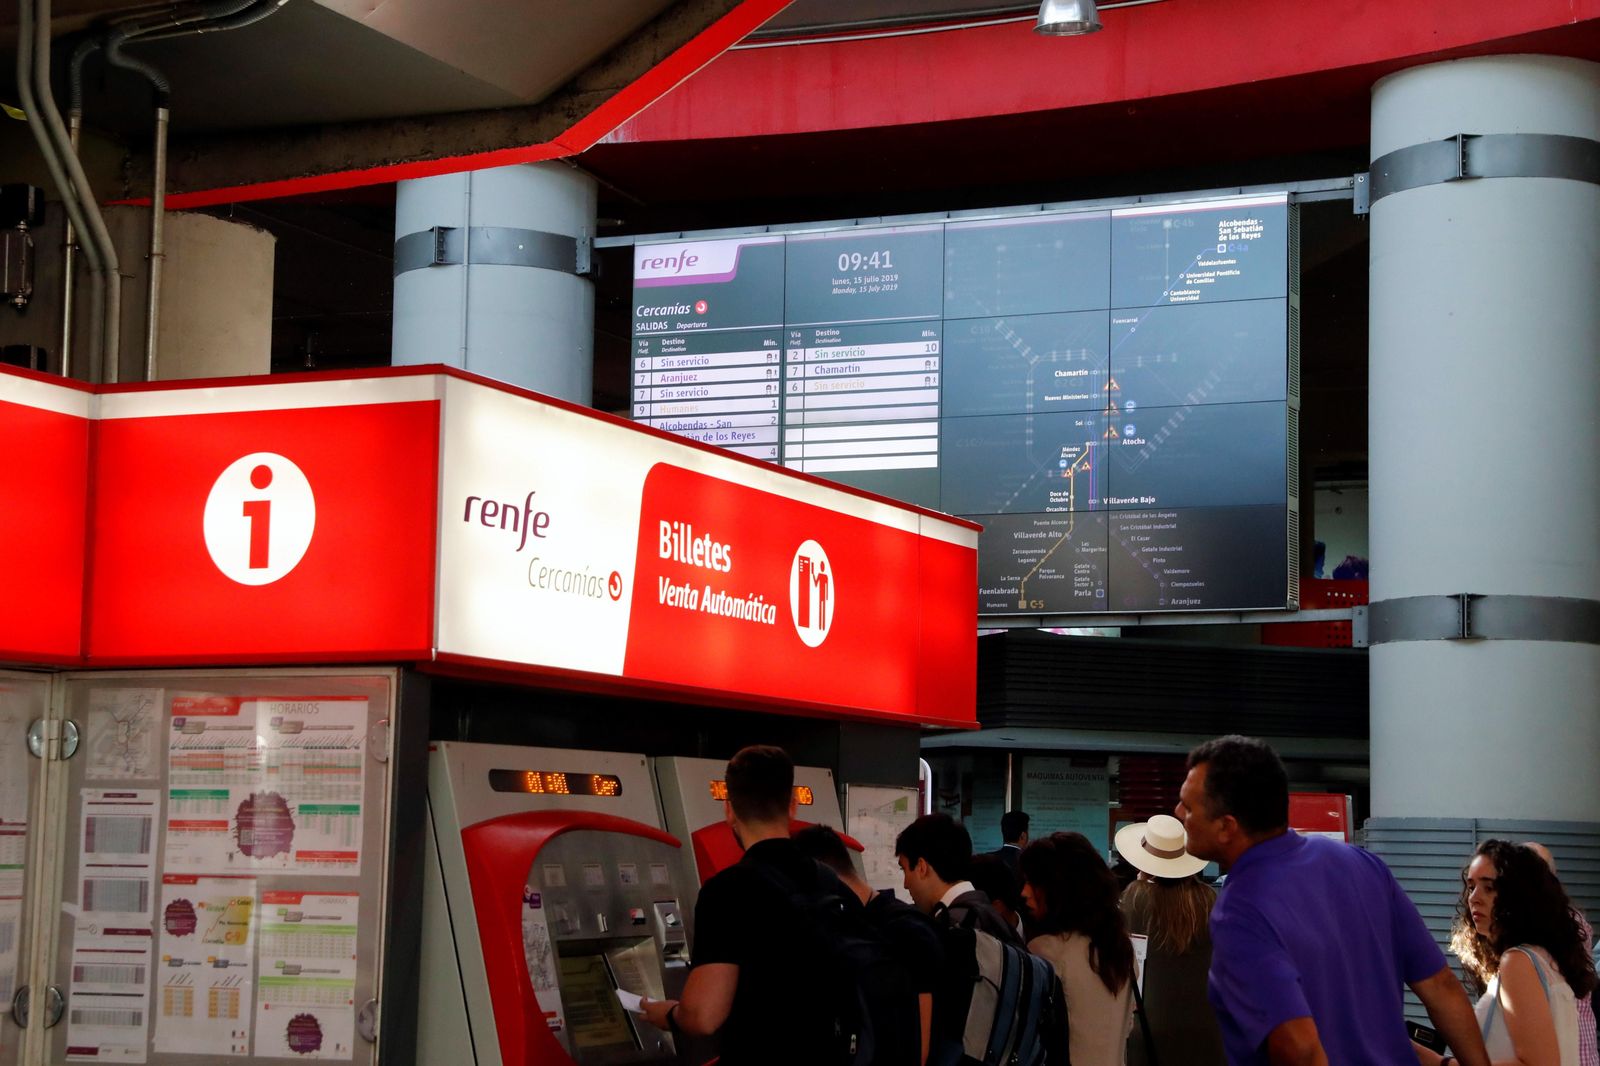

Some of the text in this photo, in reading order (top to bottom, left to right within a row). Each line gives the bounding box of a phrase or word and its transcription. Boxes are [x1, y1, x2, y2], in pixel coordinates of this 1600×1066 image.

[1218, 218, 1258, 228] Alcobendas
[1242, 232, 1261, 240] Reyes
[641, 249, 699, 274] renfe
[838, 250, 893, 272] 09:41
[864, 275, 880, 284] julio
[881, 274, 899, 282] 2019
[832, 286, 857, 295] Monday,
[636, 302, 691, 318] Cercanías
[636, 320, 708, 332] SALIDAS Departures
[925, 343, 937, 352] 10
[793, 351, 798, 359] 2
[815, 348, 866, 359] Sin servicio
[640, 360, 646, 368] 6
[660, 356, 709, 368] Sin servicio
[792, 367, 798, 375] 7
[1055, 369, 1088, 377] Chamartín
[640, 375, 646, 384] 7
[660, 372, 698, 384] Aranjuez
[792, 382, 798, 391] 6
[814, 380, 865, 391] Sin servicio
[640, 390, 645, 399] 7
[660, 388, 709, 398] Sin servicio
[660, 404, 698, 413] Humanes
[772, 400, 777, 408] 1
[639, 406, 645, 415] 9
[660, 421, 708, 431] Alcobendas
[716, 420, 732, 428] San
[771, 416, 776, 425] 2
[703, 432, 713, 441] de
[716, 432, 728, 440] los
[731, 431, 756, 442] Reyes
[770, 448, 776, 456] 4
[1140, 496, 1155, 504] Bajo
[464, 490, 550, 552] renfe
[658, 520, 732, 573] Billetes
[528, 557, 604, 599] Cercanías
[658, 576, 776, 625] Venta Automática
[1030, 600, 1044, 609] C-5
[270, 702, 320, 714] HORARIOS
[594, 775, 618, 795] Cer
